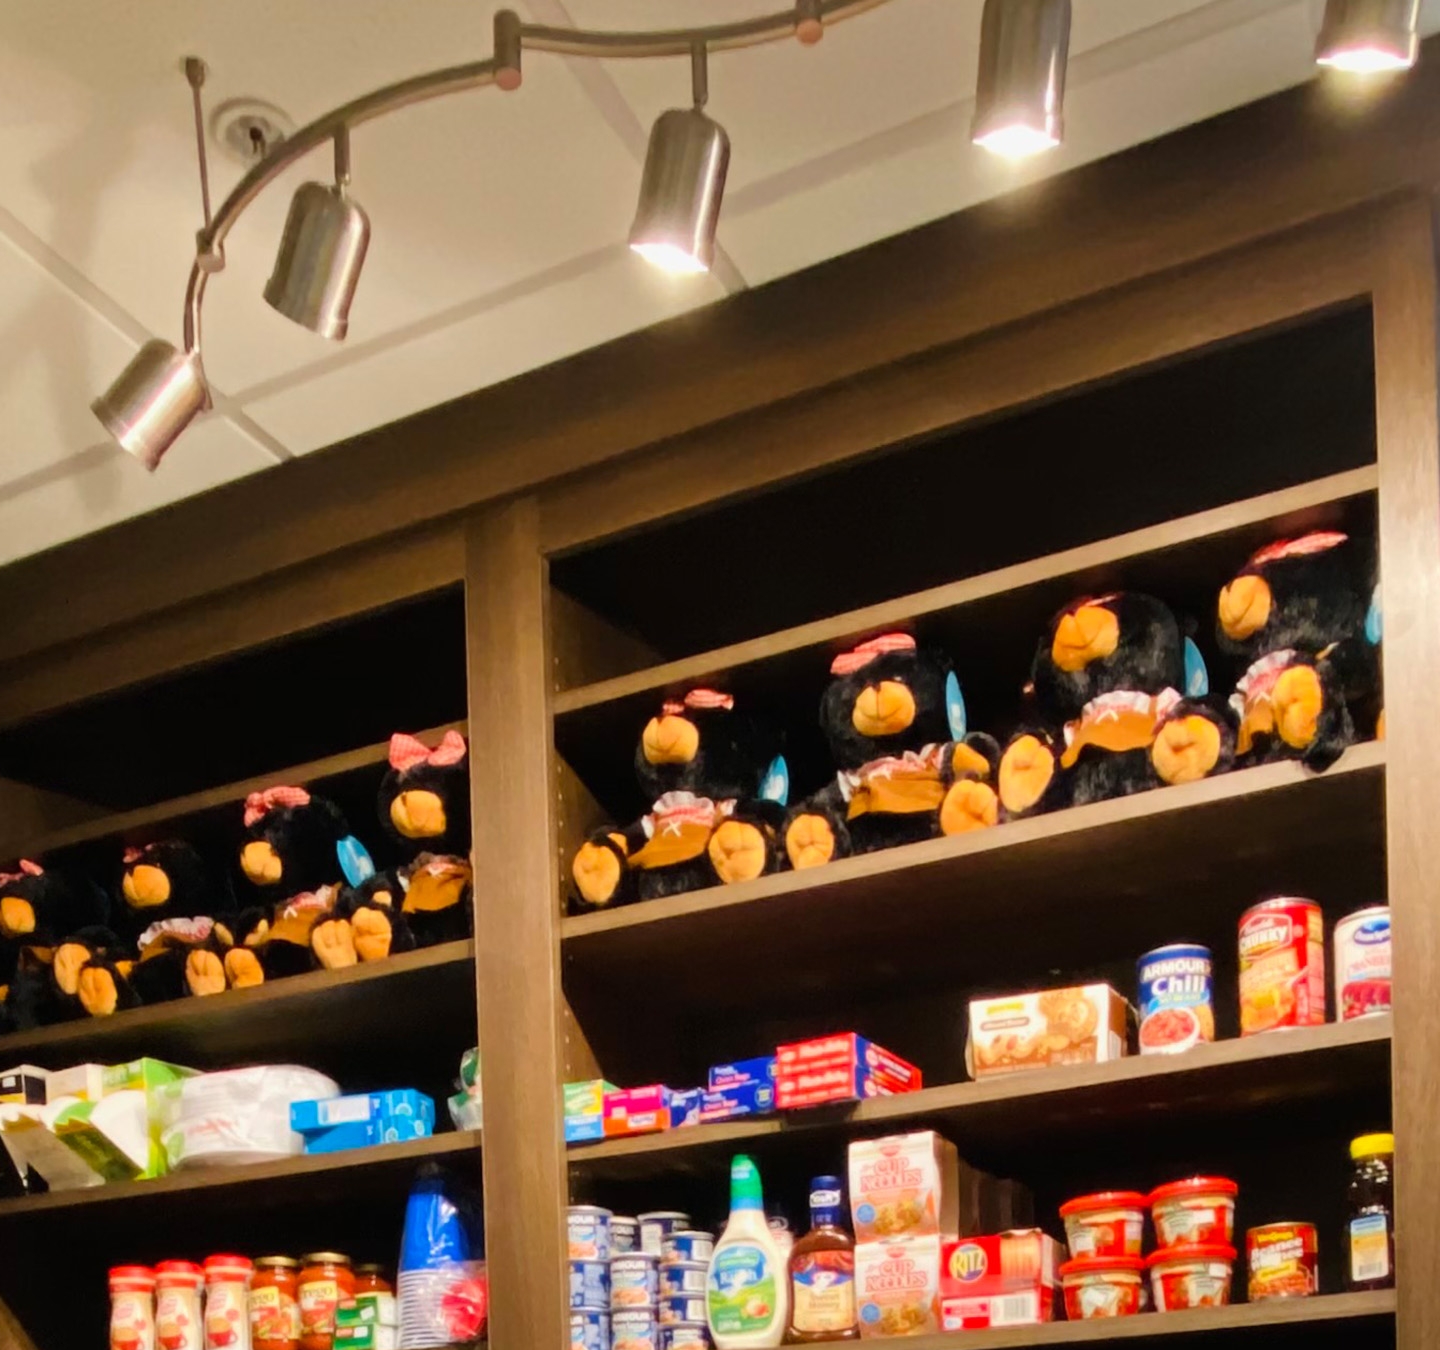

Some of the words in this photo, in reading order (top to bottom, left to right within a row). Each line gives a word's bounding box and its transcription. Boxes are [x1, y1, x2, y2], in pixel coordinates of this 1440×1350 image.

[1143, 960, 1204, 980] ARMOUR
[1151, 975, 1207, 994] Chili
[950, 1251, 986, 1277] RITZ
